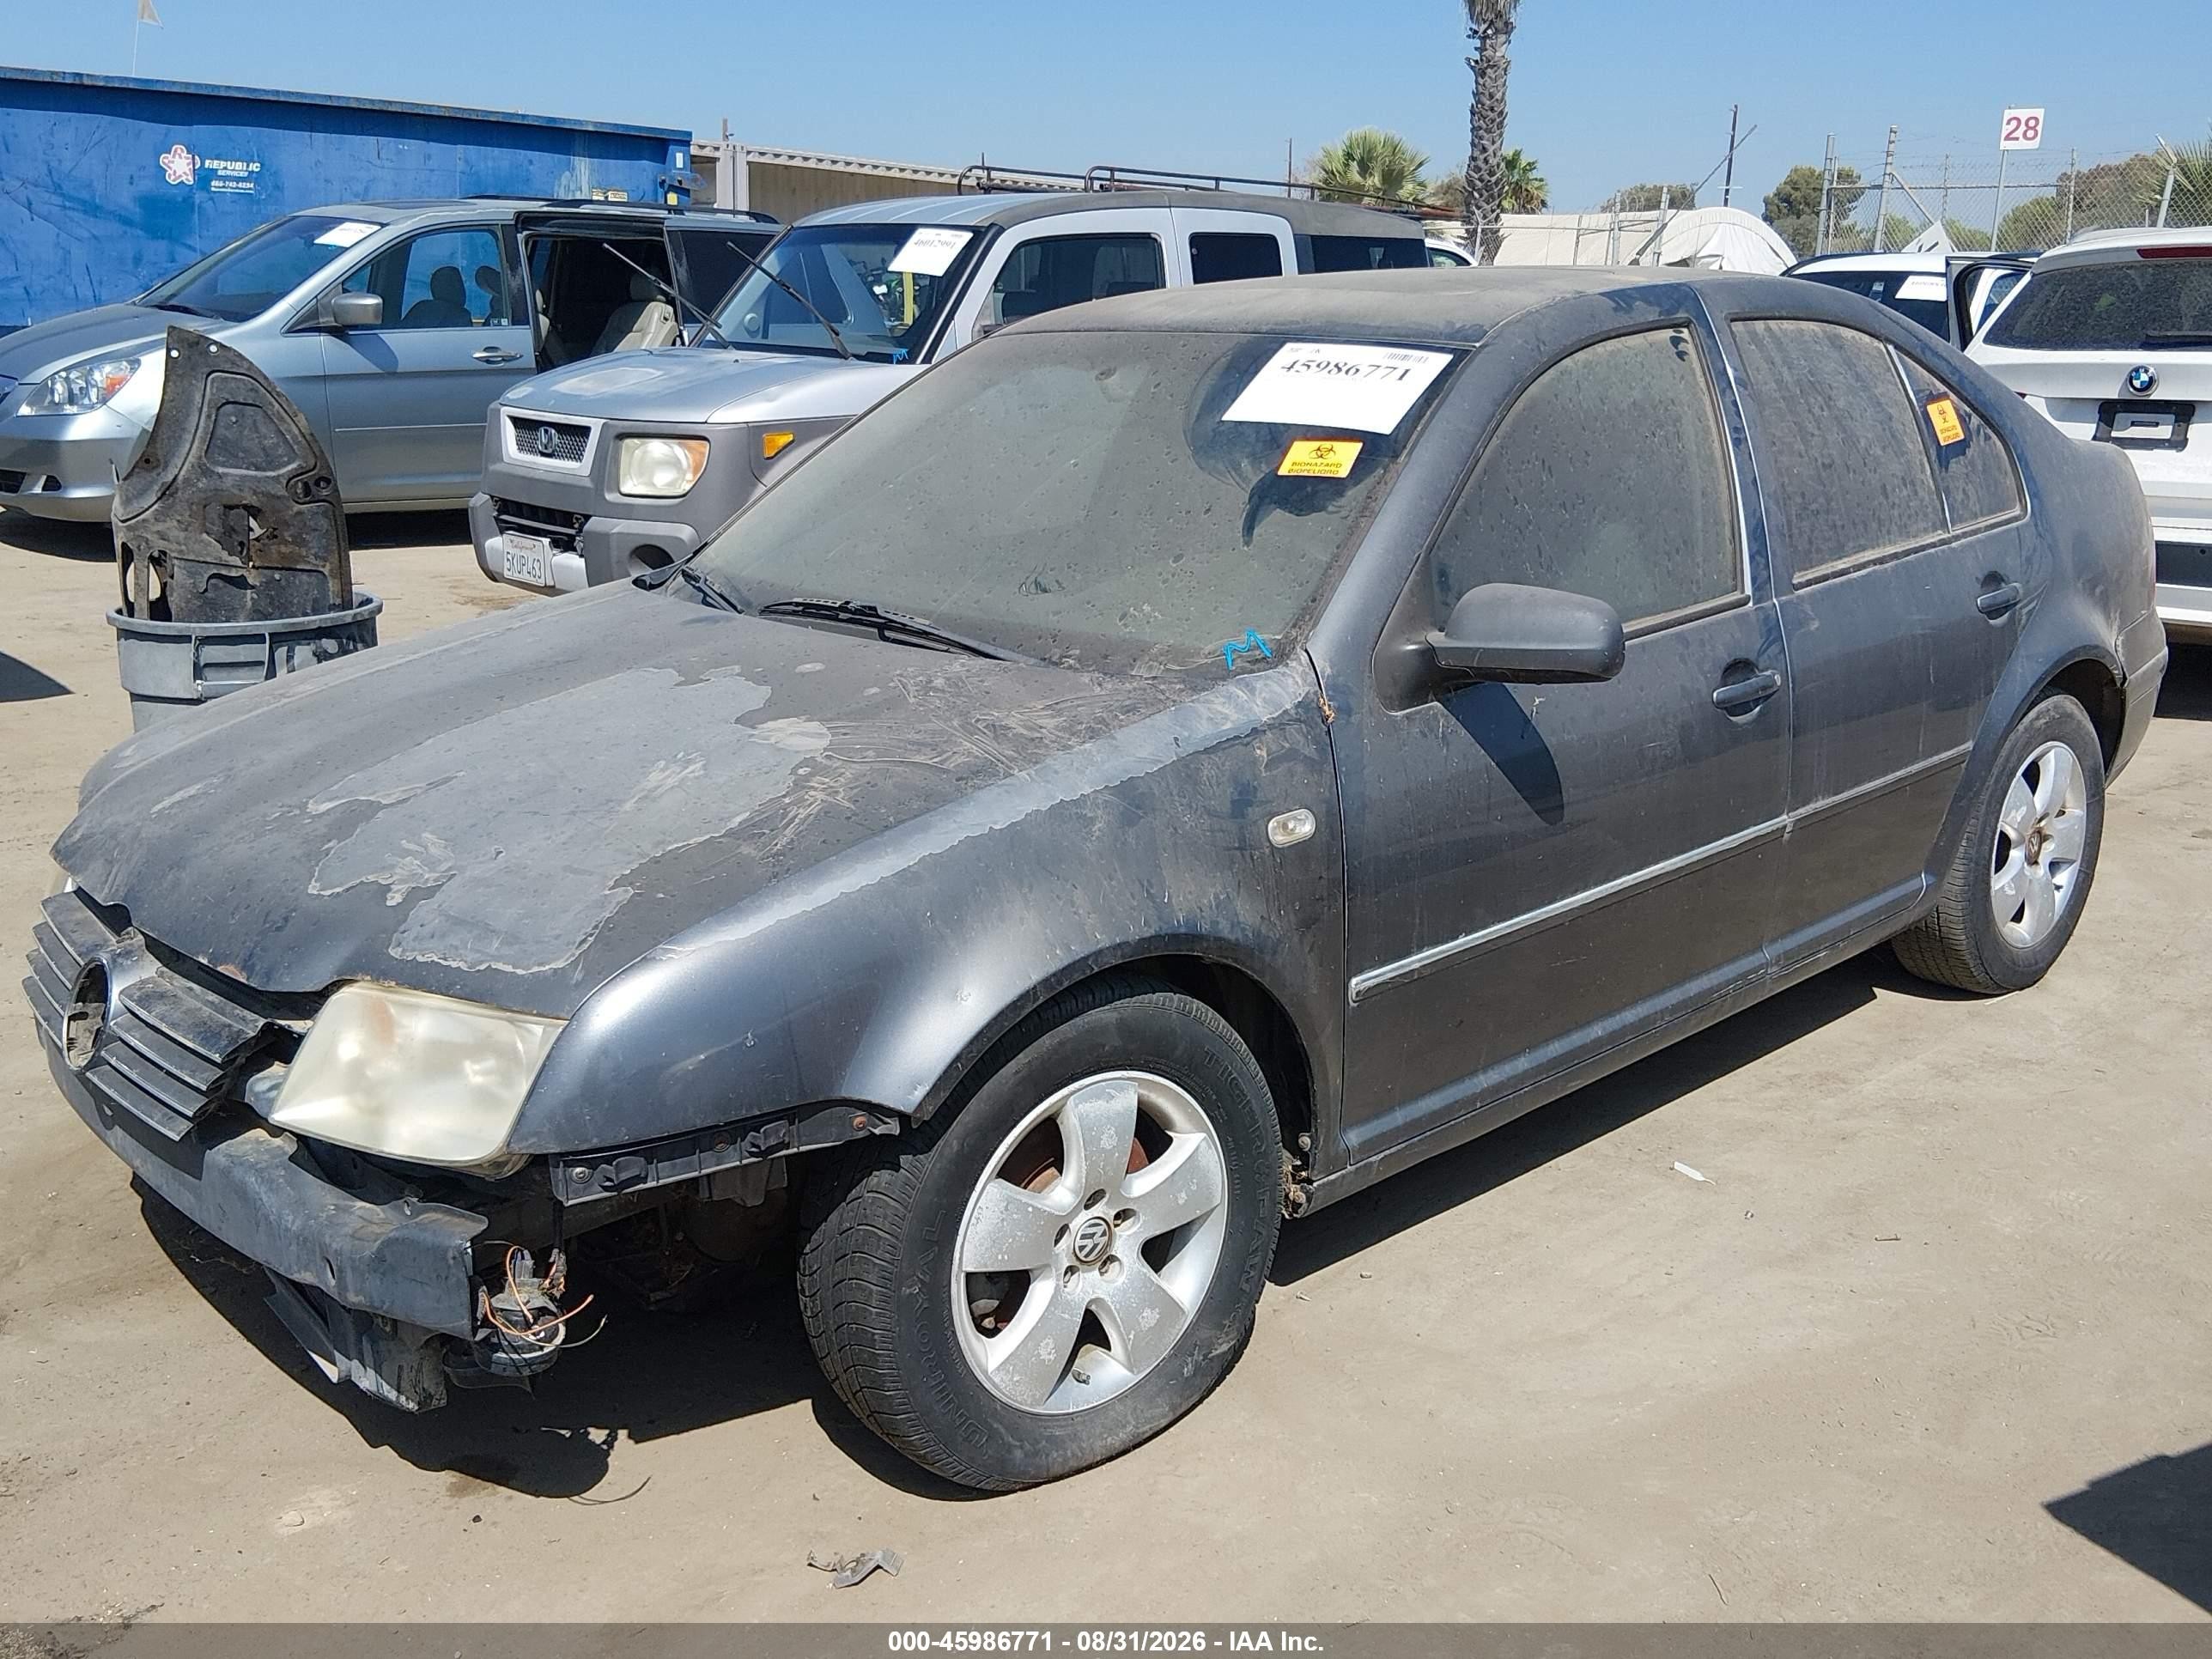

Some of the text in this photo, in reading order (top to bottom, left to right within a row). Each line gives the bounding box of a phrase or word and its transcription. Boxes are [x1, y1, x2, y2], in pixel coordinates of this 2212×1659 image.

[2003, 116, 2039, 142] 28
[204, 159, 261, 172] REPUBLIC
[1280, 359, 1412, 381] 45986771
[506, 551, 543, 579] 5KUP463
[1203, 1045, 1271, 1292] TIGER PAW
